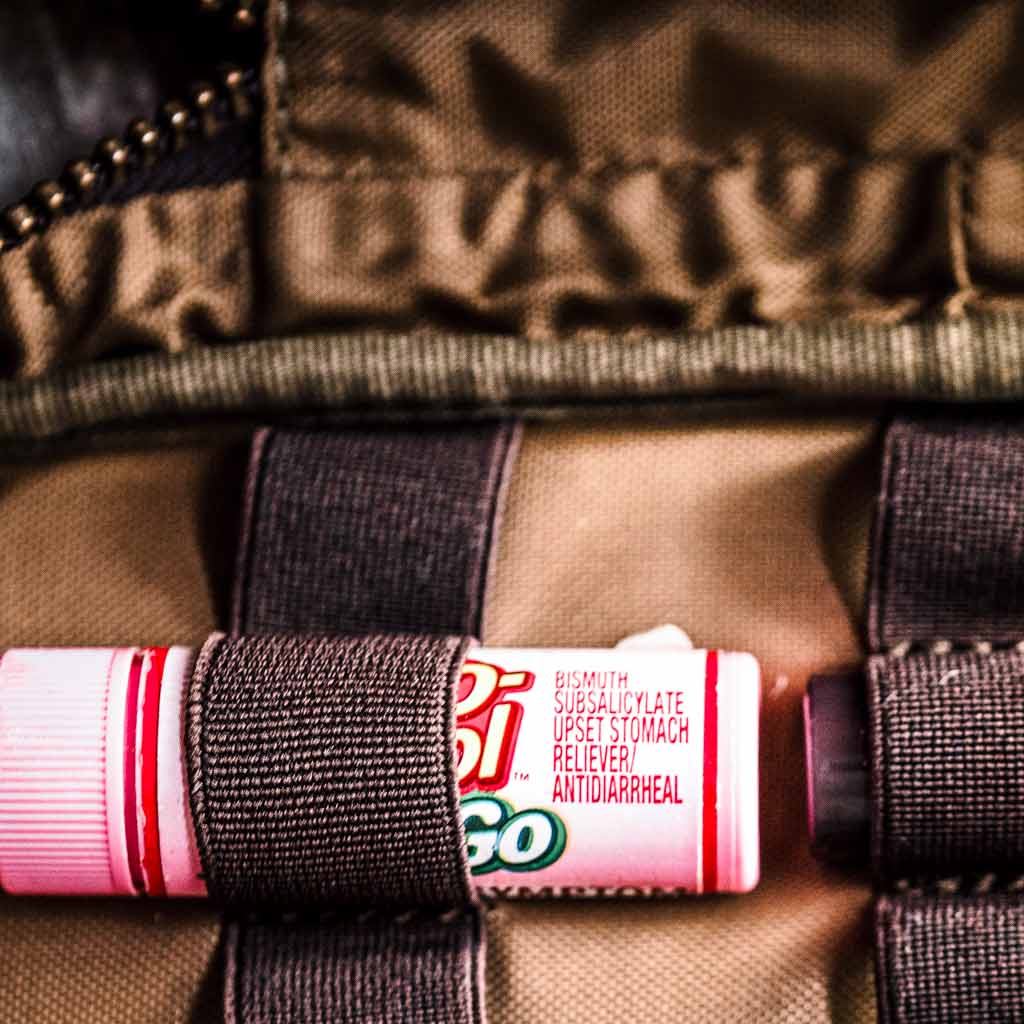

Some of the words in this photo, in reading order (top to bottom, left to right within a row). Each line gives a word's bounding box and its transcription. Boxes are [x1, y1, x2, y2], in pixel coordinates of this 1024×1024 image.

[555, 671, 628, 689] BISMUTH
[554, 691, 684, 714] SUBSALICYLATE
[553, 717, 604, 743] UPSET
[610, 717, 689, 744] STOMACH
[553, 745, 637, 773] RELIEVER/
[552, 775, 683, 804] ANTIDIARRHEAL
